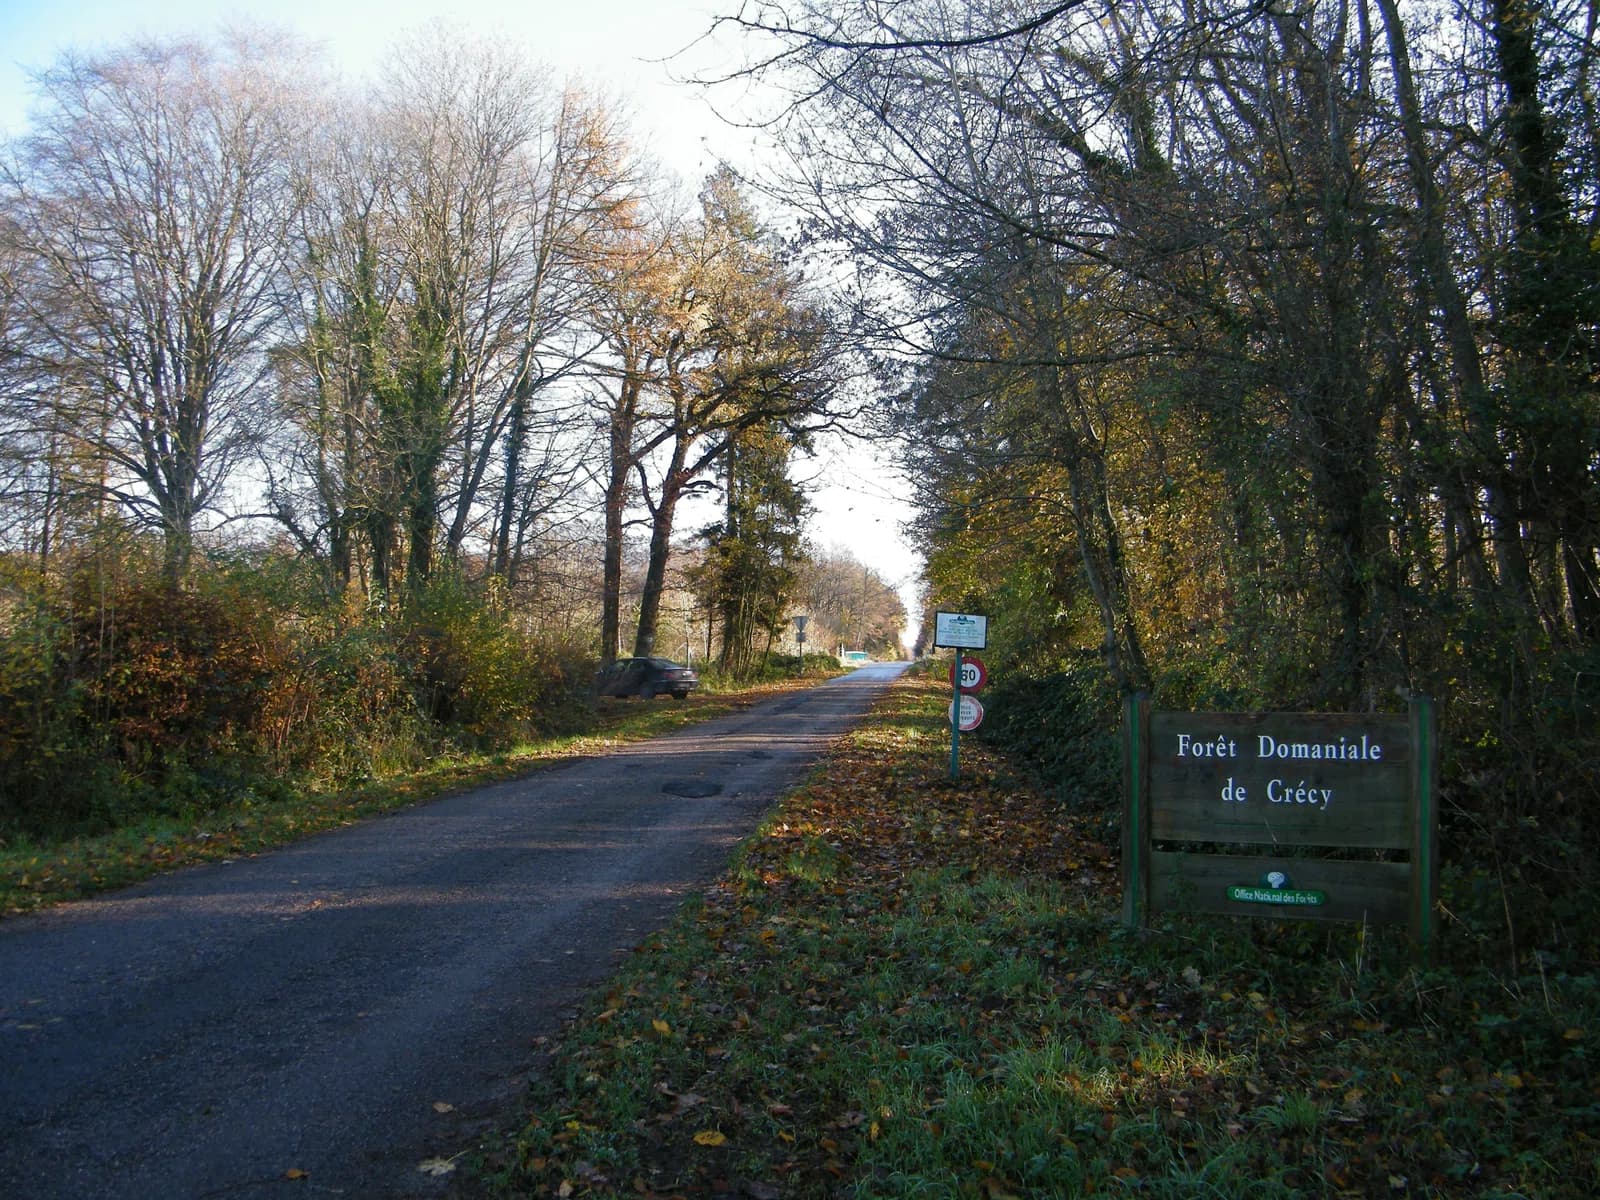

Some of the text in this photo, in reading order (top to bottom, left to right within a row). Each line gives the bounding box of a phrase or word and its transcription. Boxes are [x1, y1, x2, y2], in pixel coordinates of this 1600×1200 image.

[961, 669, 976, 681] 60
[1177, 734, 1382, 760] Forêt Domaniale
[1221, 777, 1332, 810] de Crécy
[1234, 888, 1253, 899] Office
[1283, 892, 1295, 902] des
